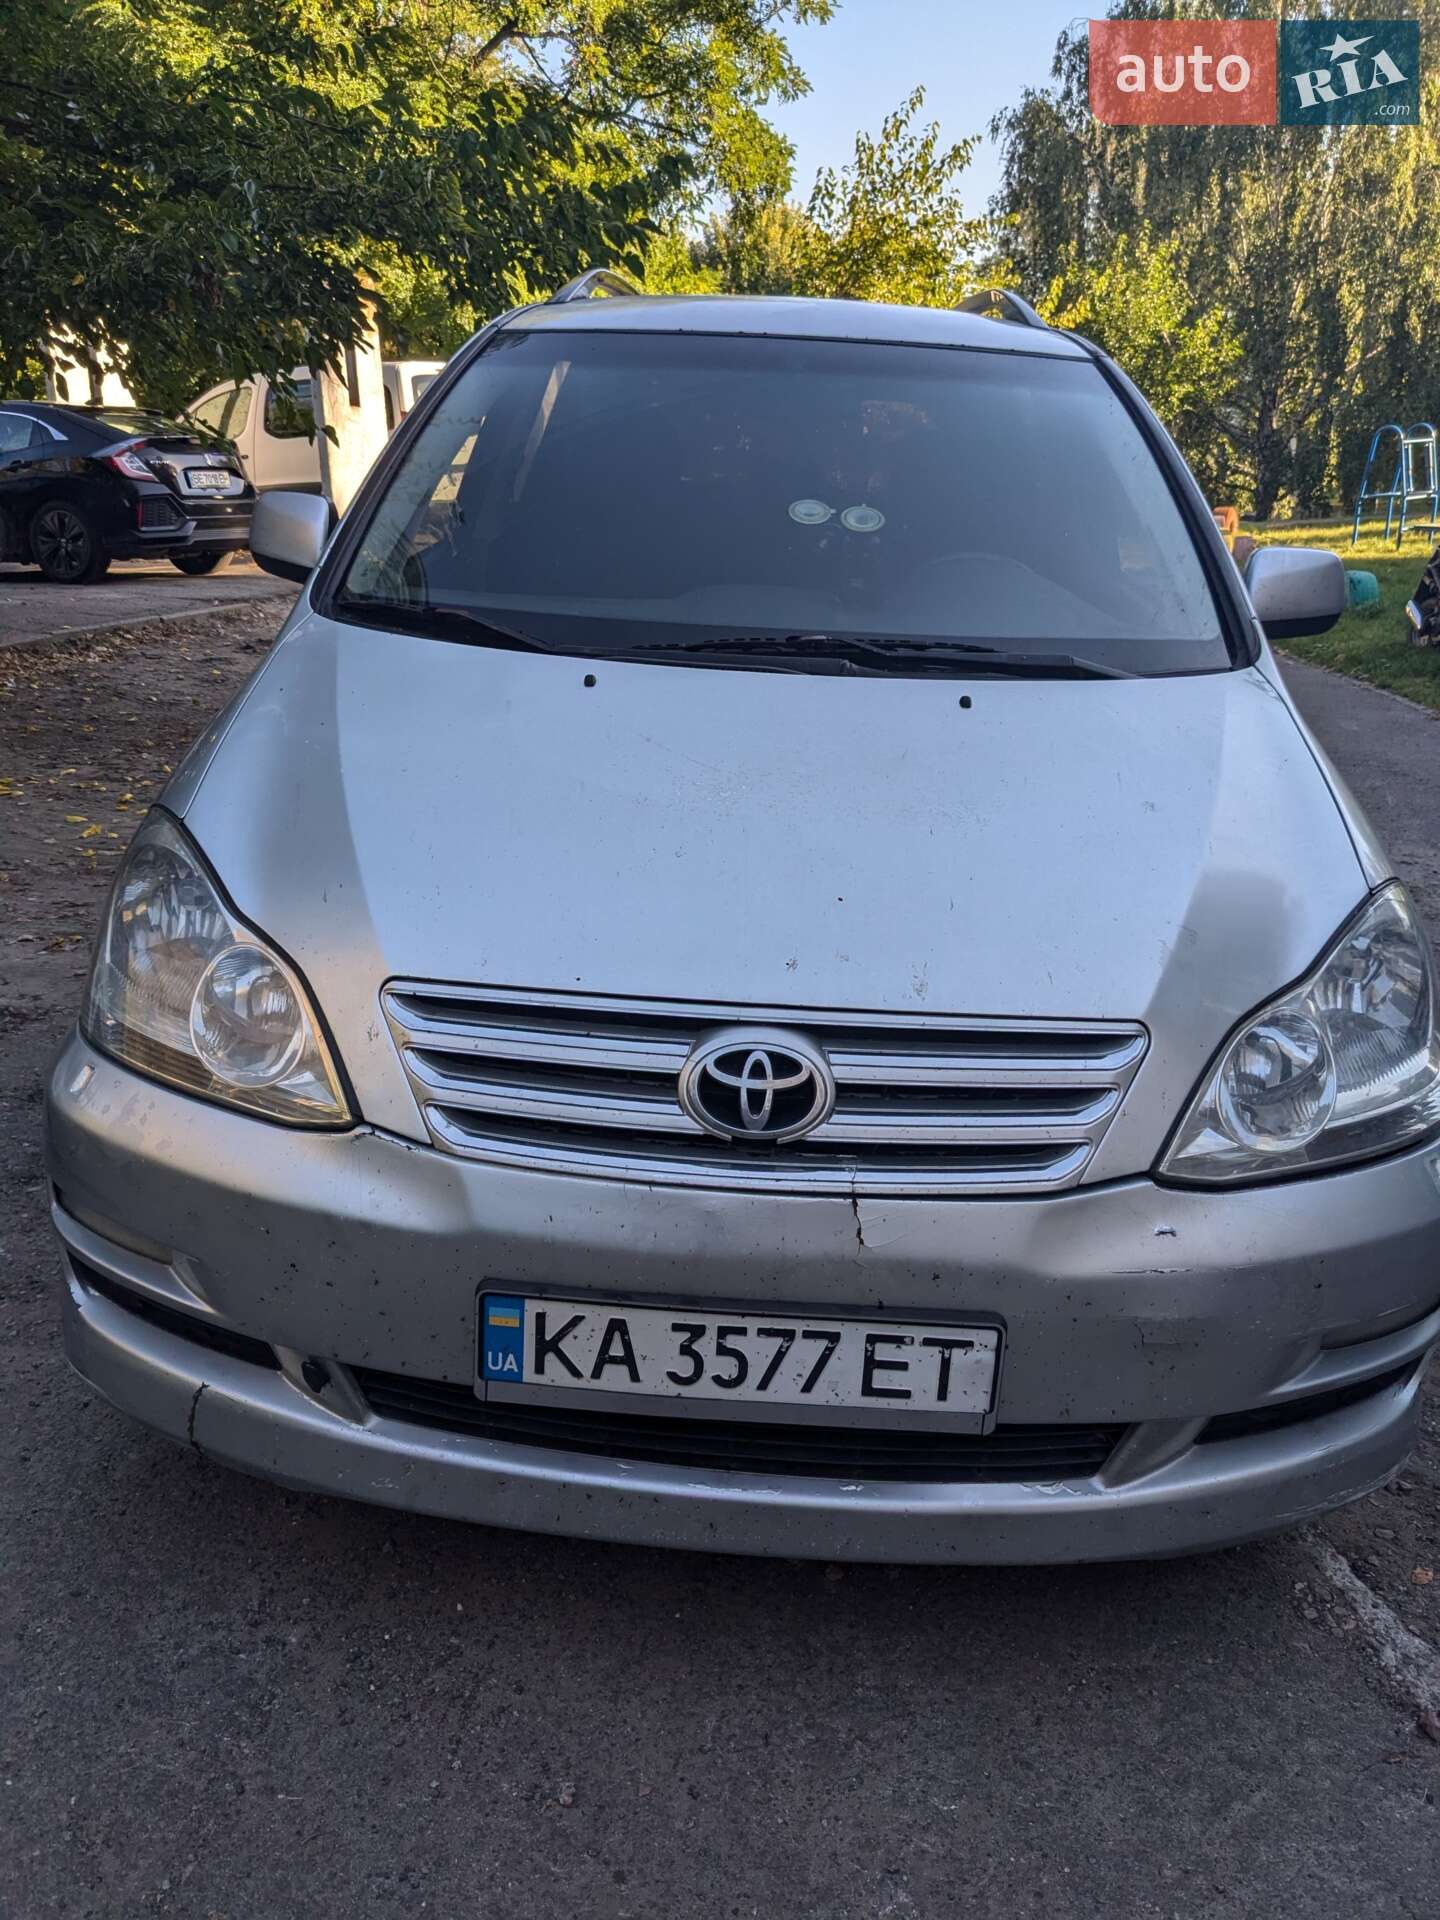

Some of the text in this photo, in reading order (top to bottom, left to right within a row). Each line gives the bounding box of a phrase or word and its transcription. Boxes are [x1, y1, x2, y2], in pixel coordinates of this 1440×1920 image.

[487, 1351, 519, 1373] UA
[534, 1311, 975, 1401] KA 3577 ET
